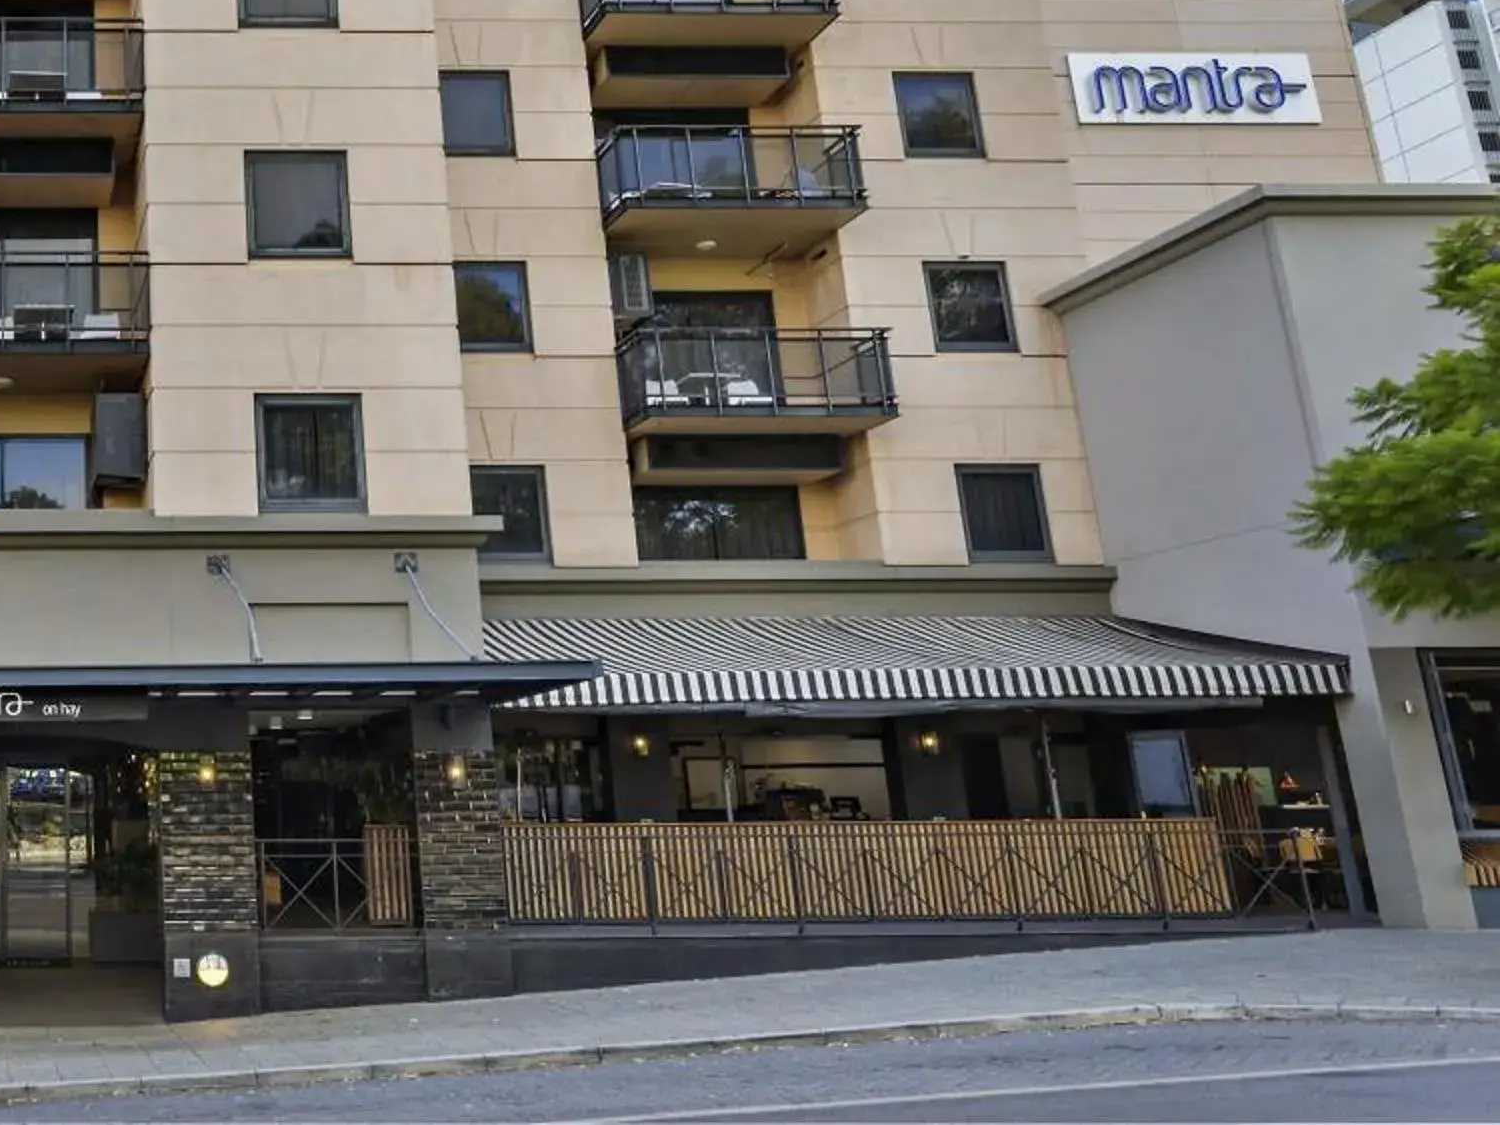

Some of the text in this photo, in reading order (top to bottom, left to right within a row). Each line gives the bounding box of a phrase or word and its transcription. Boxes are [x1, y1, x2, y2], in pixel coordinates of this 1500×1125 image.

[1091, 59, 1307, 113] mantra
[43, 705, 58, 716] on
[60, 702, 82, 718] hay
